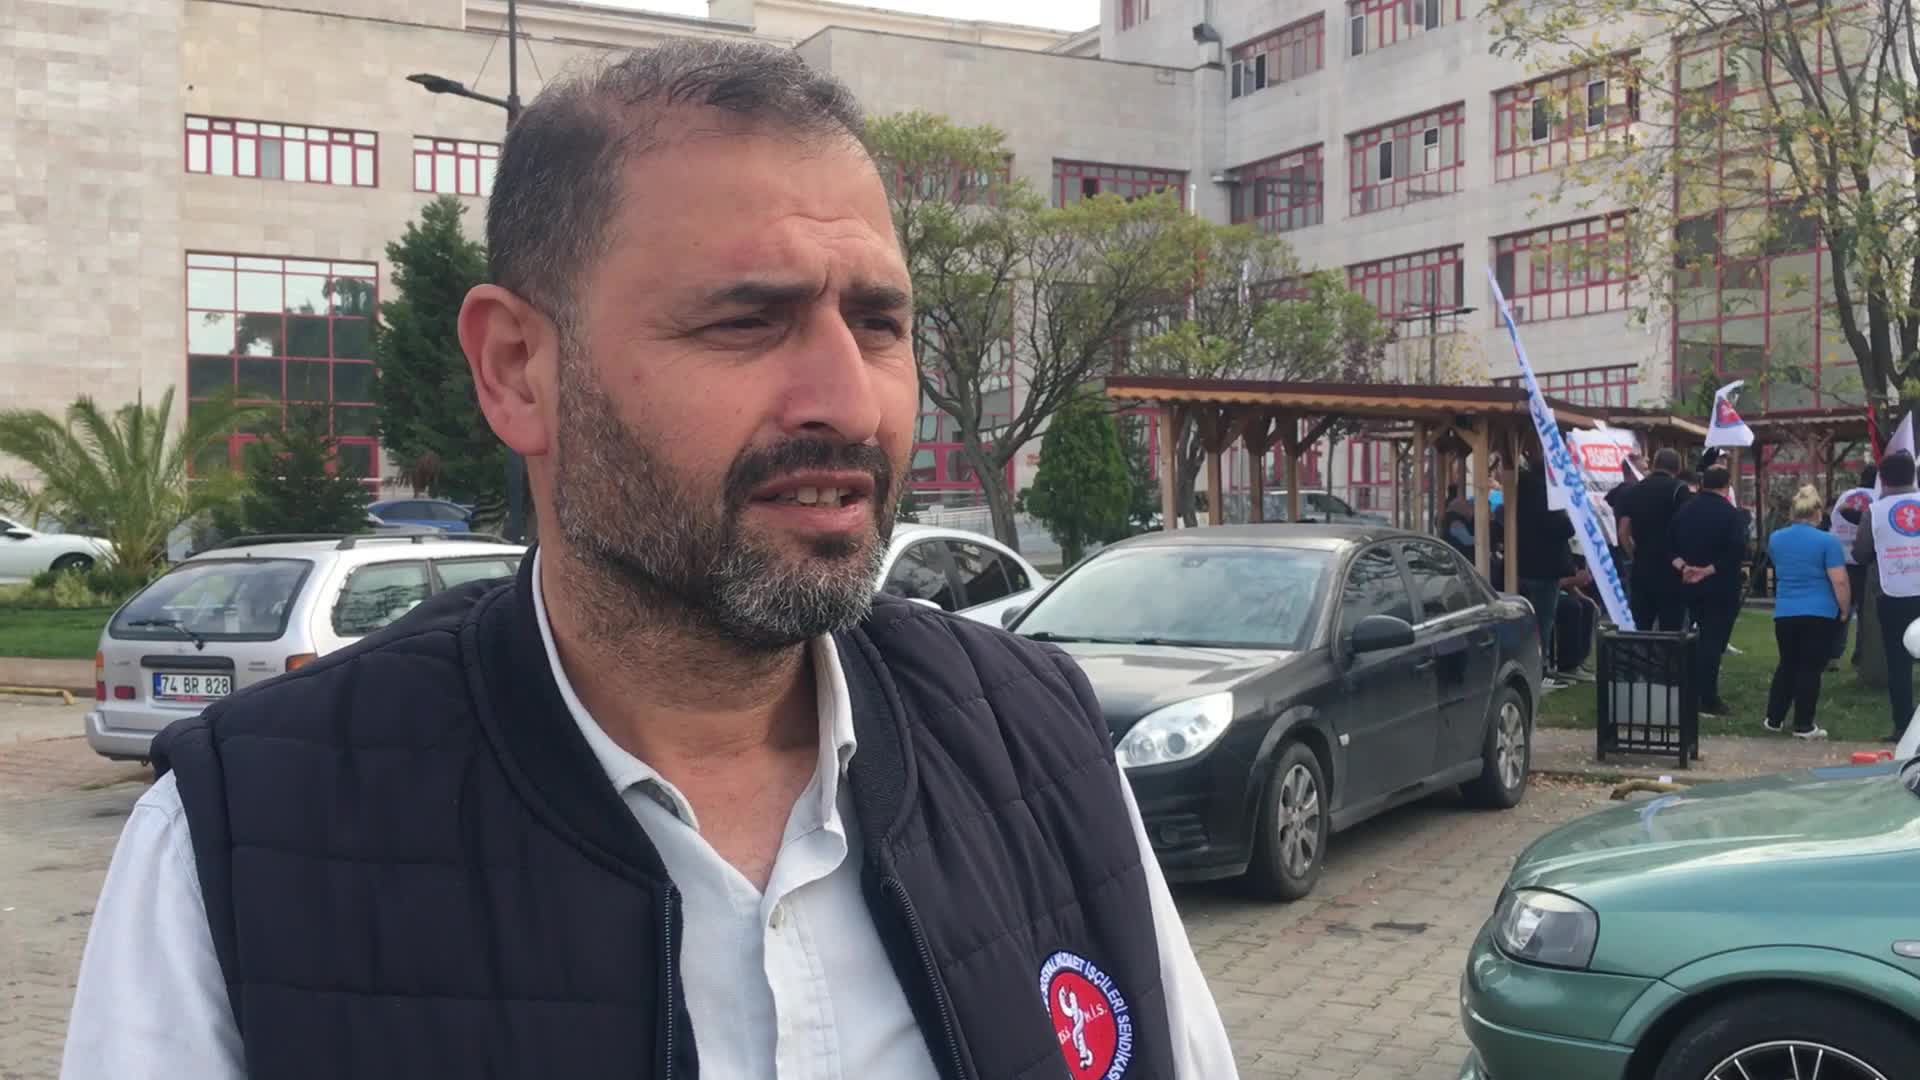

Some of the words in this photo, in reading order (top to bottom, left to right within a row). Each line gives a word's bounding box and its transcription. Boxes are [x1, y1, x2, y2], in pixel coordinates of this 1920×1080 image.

[162, 676, 178, 693] 74
[183, 677, 199, 693] BR
[205, 678, 229, 694] 828
[1085, 961, 1128, 1013] İŞÇİLERİ
